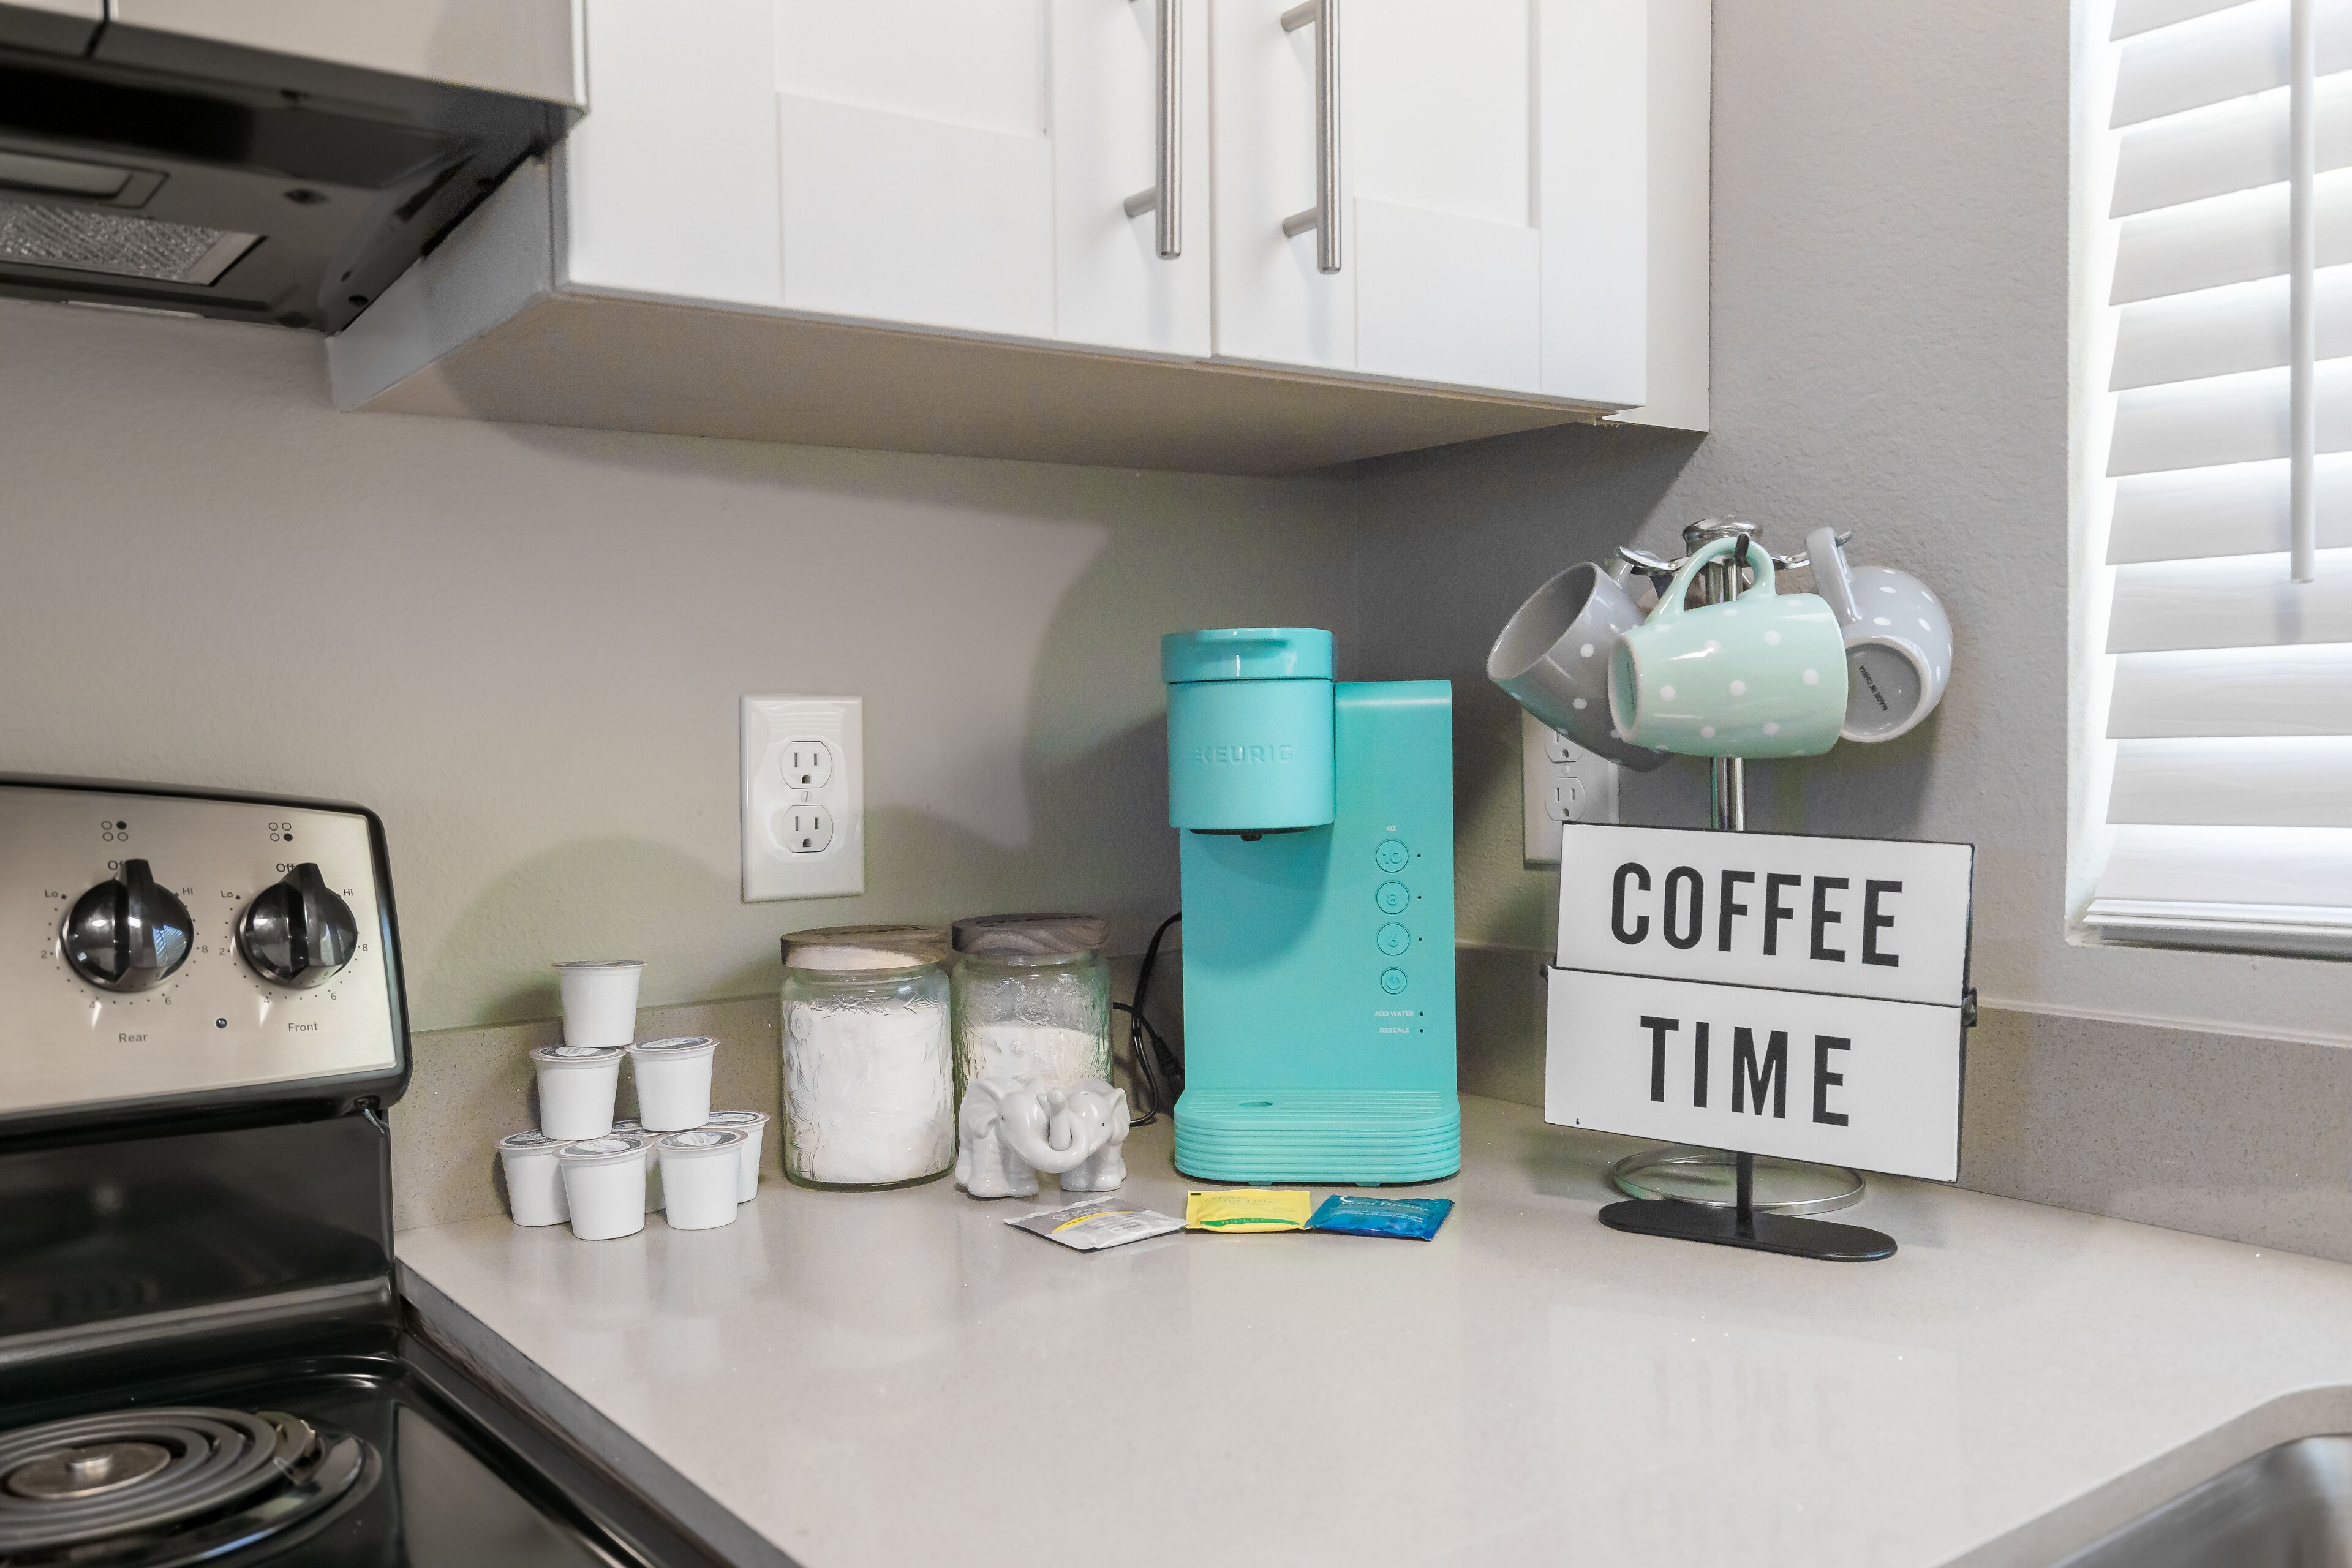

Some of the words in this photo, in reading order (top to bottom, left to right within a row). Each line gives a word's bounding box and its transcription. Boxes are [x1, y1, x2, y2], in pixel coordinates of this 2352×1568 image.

[1858, 665, 1874, 685] CHINA
[1869, 685, 1878, 693] IN
[1874, 692, 1888, 711] MADE
[1196, 745, 1294, 764] KEURIG
[1382, 851, 1401, 865] 10
[44, 889, 59, 899] Lo
[183, 887, 194, 895] Hi
[221, 890, 233, 899] Lo
[1387, 893, 1398, 906] 8
[1611, 862, 1903, 967] COFFEE
[1388, 933, 1398, 948] 6
[202, 945, 209, 954] 8
[219, 948, 225, 956] 2
[362, 943, 369, 952] 8
[40, 950, 48, 959] 2
[165, 997, 172, 1006] 6
[263, 996, 270, 1005] 4
[288, 1022, 318, 1033] Front
[118, 1033, 148, 1043] Rear
[1640, 1014, 1852, 1127] TIME
